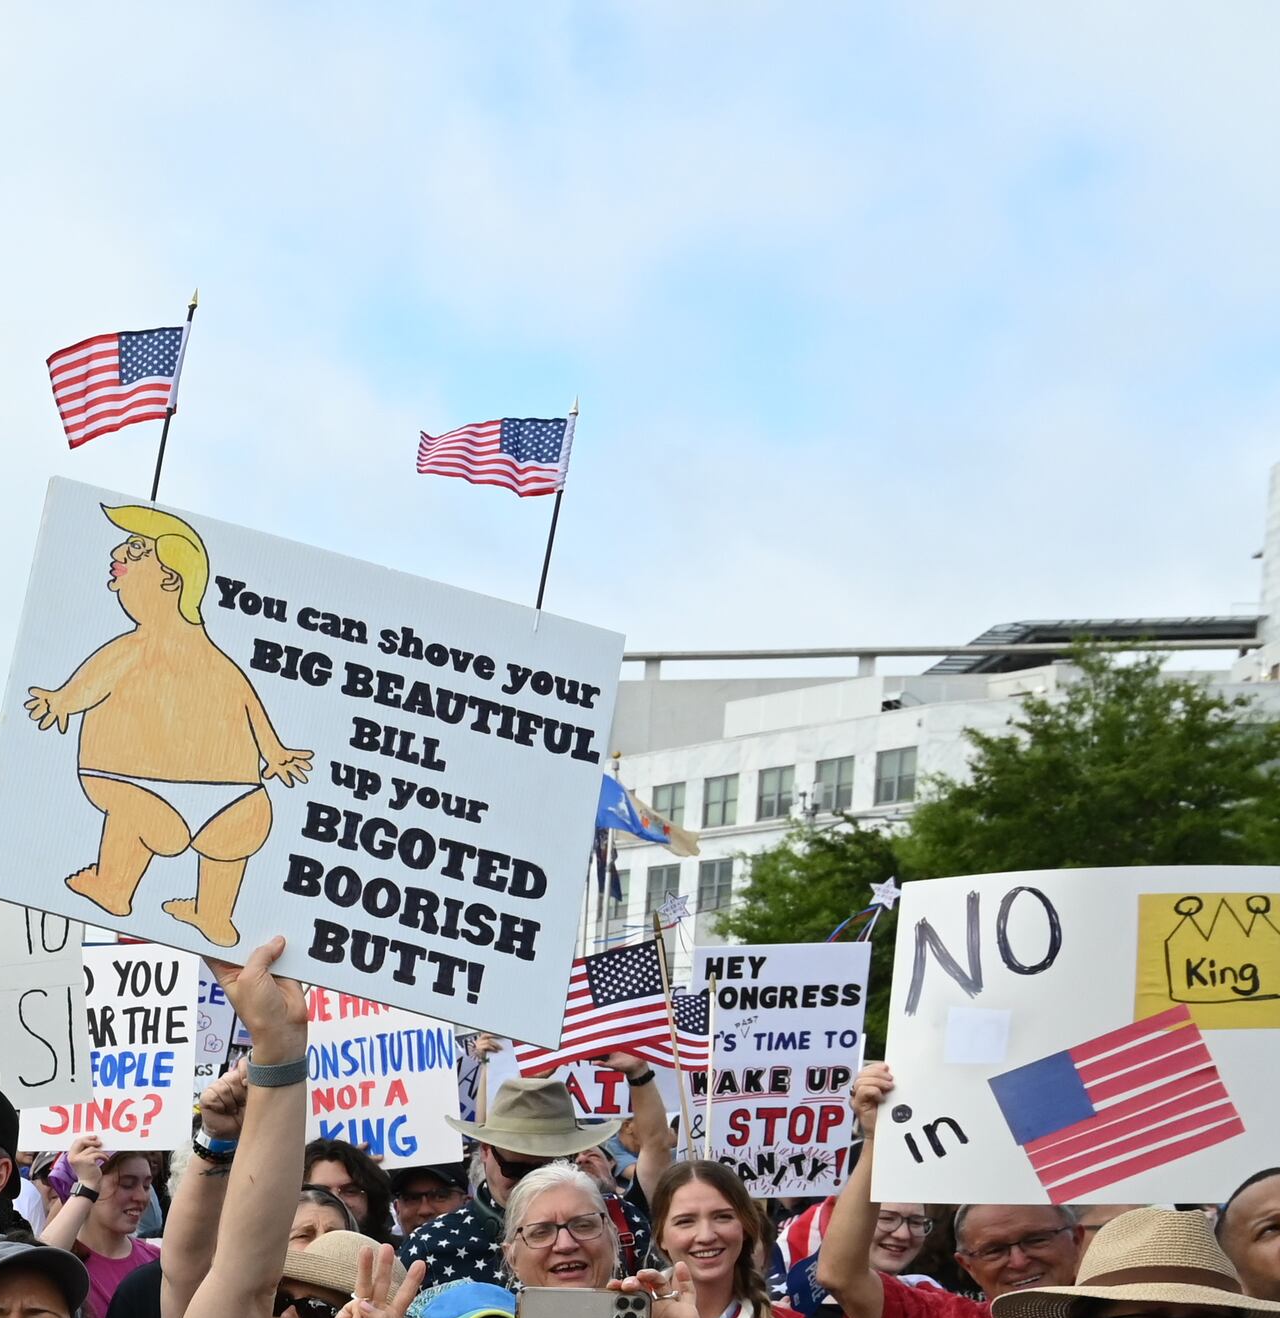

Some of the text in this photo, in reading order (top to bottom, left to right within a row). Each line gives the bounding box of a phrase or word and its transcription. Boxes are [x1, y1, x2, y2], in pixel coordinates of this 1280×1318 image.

[214, 576, 600, 710] You can shove your
[249, 638, 600, 765] BIG BEAUTIFUL
[350, 716, 446, 772] BILL
[330, 761, 489, 825] up your
[301, 801, 547, 900] BIGOTED
[282, 853, 542, 961] BOORISH
[308, 918, 486, 1005] BUTT!
[704, 956, 767, 981] HEY
[904, 886, 1261, 1016] NO King
[112, 960, 179, 997] YOU
[700, 983, 862, 1010] ONGRESS
[122, 1005, 189, 1045] THE
[754, 1029, 858, 1051] TIME TO
[90, 1051, 174, 1089] EOPLE
[307, 1027, 453, 1081] ONSTITUTION
[311, 1078, 409, 1116] NOT A
[690, 1066, 851, 1097] WAKE UP
[40, 1093, 163, 1138] SING?
[319, 1114, 418, 1158] KING
[690, 1105, 845, 1147] & STOP
[891, 1104, 969, 1164] in
